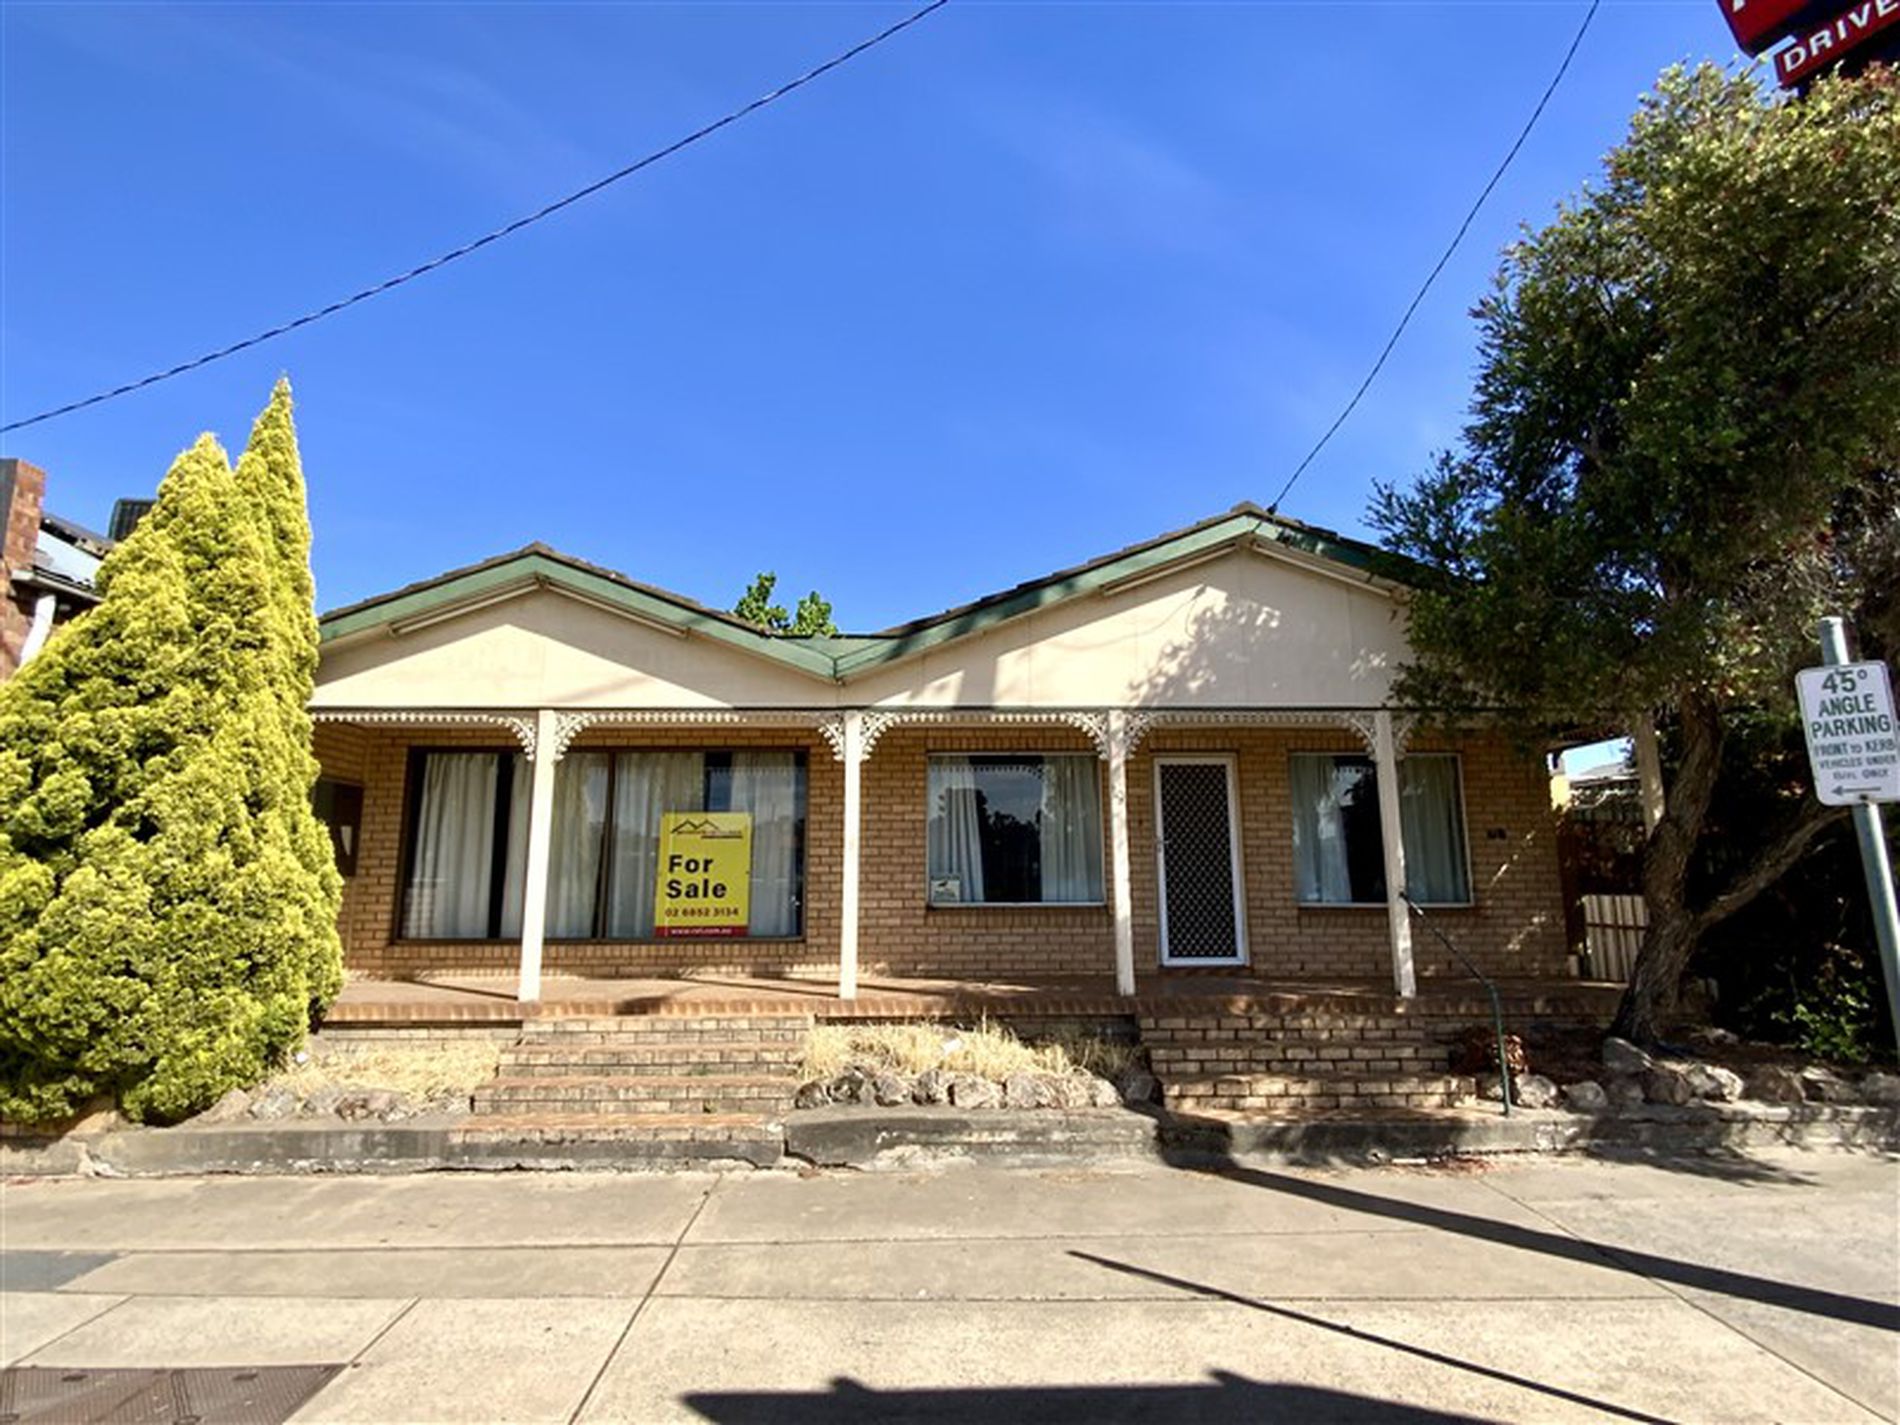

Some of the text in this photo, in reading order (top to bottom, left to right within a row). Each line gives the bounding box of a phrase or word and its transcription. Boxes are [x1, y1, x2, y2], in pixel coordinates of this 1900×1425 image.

[1818, 693, 1876, 717] ANGLE
[1812, 714, 1891, 738] PARKING
[1814, 742, 1848, 757] FRONT
[1865, 738, 1896, 753] KERB
[1819, 754, 1897, 769] VEHICLES UNDER
[669, 854, 714, 874] For
[666, 878, 727, 899] Sale
[664, 907, 679, 917] 02
